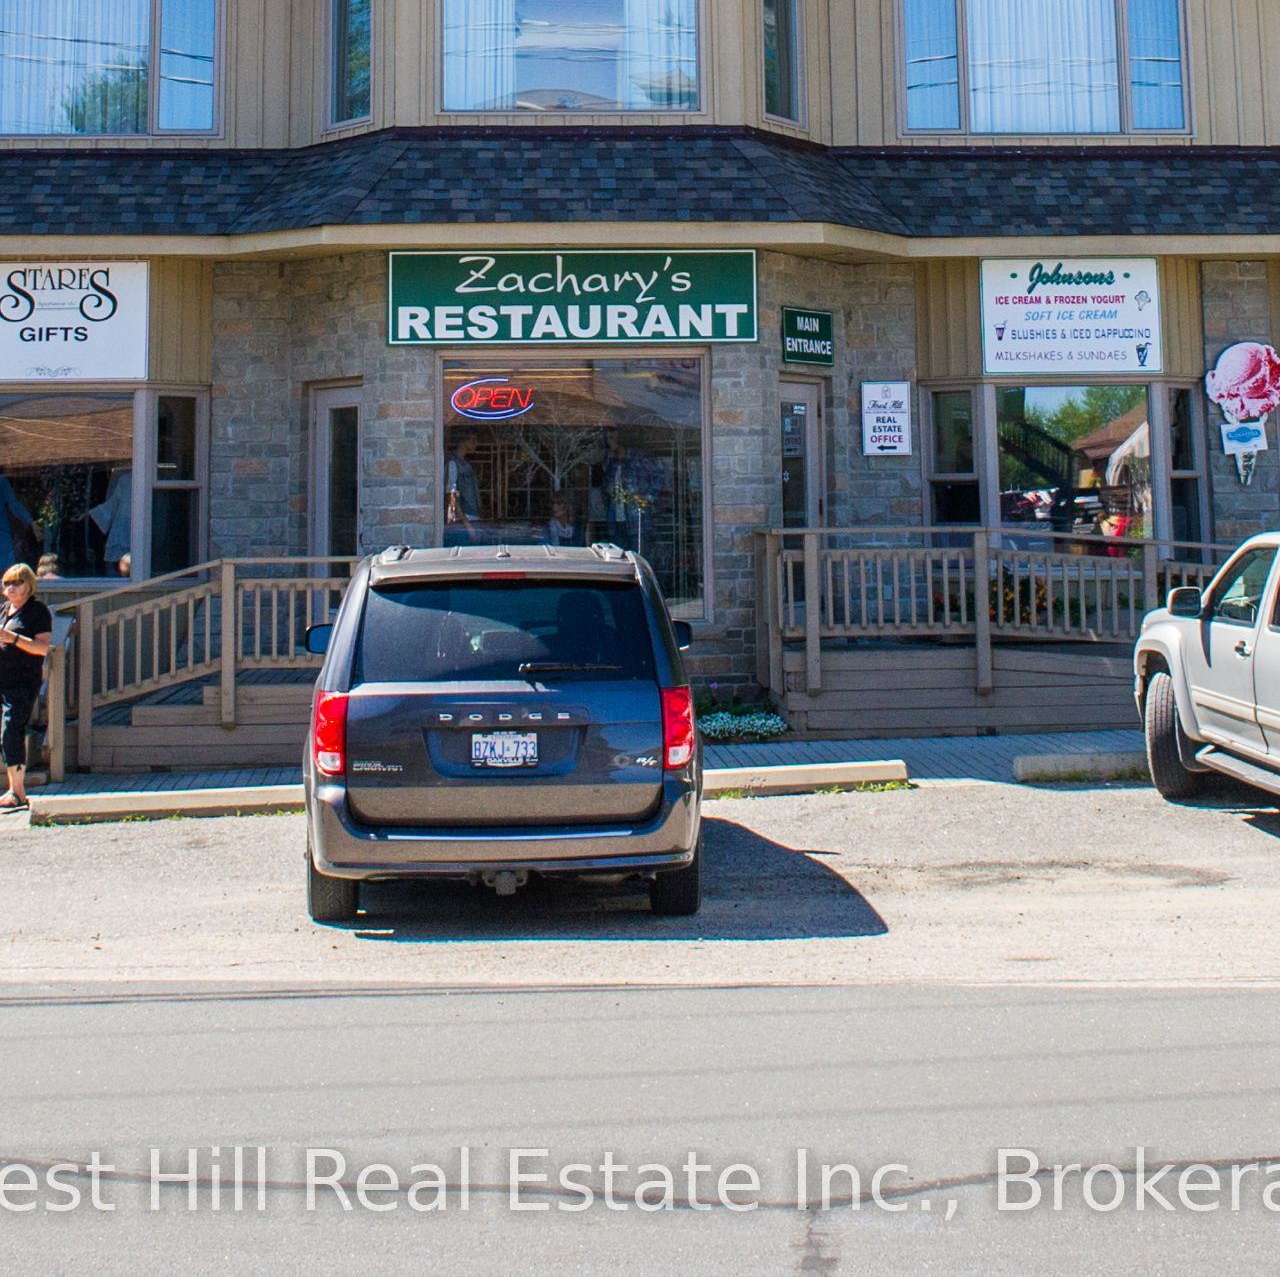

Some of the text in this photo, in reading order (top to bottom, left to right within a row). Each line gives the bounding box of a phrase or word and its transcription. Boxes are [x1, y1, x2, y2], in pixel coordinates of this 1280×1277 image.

[454, 256, 692, 303] Zachary's
[1026, 262, 1116, 294] Johnsons
[995, 295, 1126, 305] ICE CREAM & FROZEN YOGURT
[397, 303, 748, 339] RESTAURANT
[1024, 310, 1118, 321] SOFT ICE CREAM
[796, 316, 819, 332] MAIN
[20, 326, 88, 342] GIFTS
[1011, 328, 1151, 340] SLUSHIES & ICED CAPPUCCINO
[786, 337, 832, 355] ENTRANCE
[995, 350, 1063, 361] MILKSHAKES
[1077, 350, 1127, 360] SUNDAES
[454, 386, 532, 408] OPEN
[876, 416, 897, 424] REAL
[872, 425, 902, 433] ESTATE
[870, 435, 904, 443] OFFICE
[439, 712, 570, 721] DODGE
